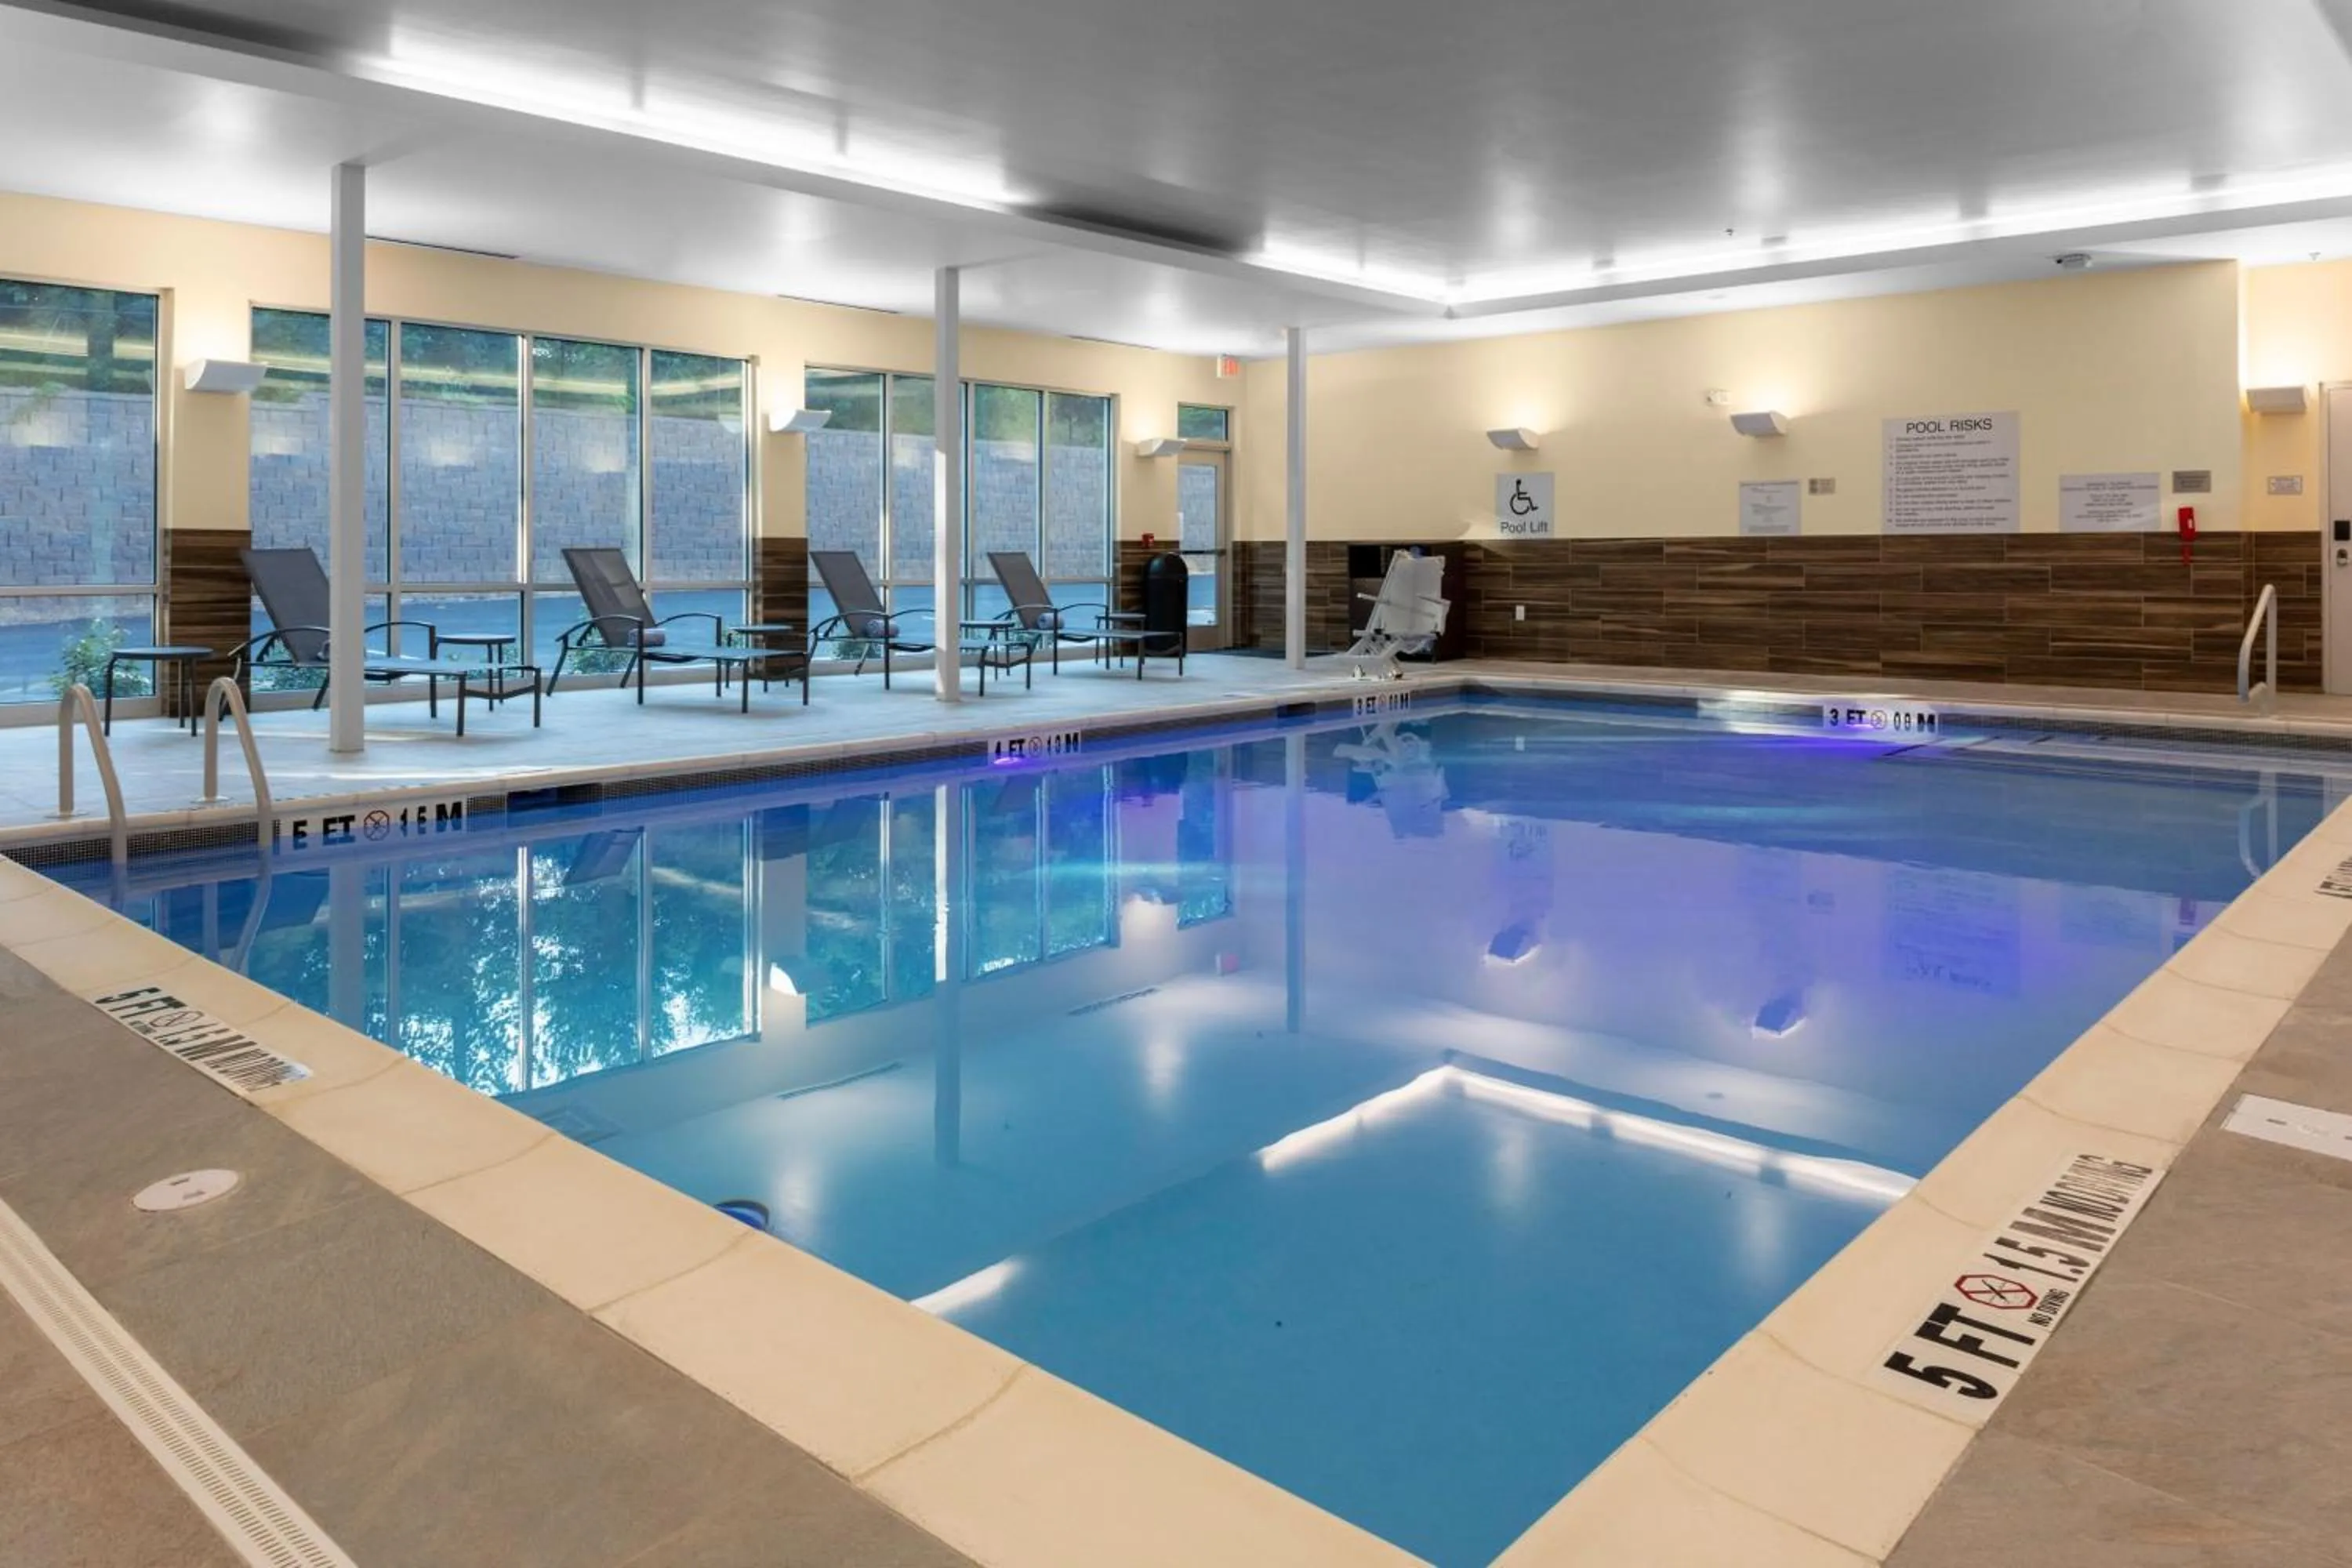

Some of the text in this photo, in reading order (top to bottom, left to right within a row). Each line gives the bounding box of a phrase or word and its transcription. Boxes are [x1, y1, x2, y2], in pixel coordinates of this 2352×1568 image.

[1906, 418, 1992, 434] POOL RISKS
[1501, 521, 1548, 533] Pool Lift
[95, 987, 162, 1004] 5
[108, 996, 188, 1019] FT
[2009, 1207, 2116, 1252] M
[1983, 1237, 2090, 1283] 1.5
[2027, 1288, 2071, 1327] NO DIVING
[1914, 1302, 2036, 1369] FT
[1883, 1352, 1998, 1399] 5
